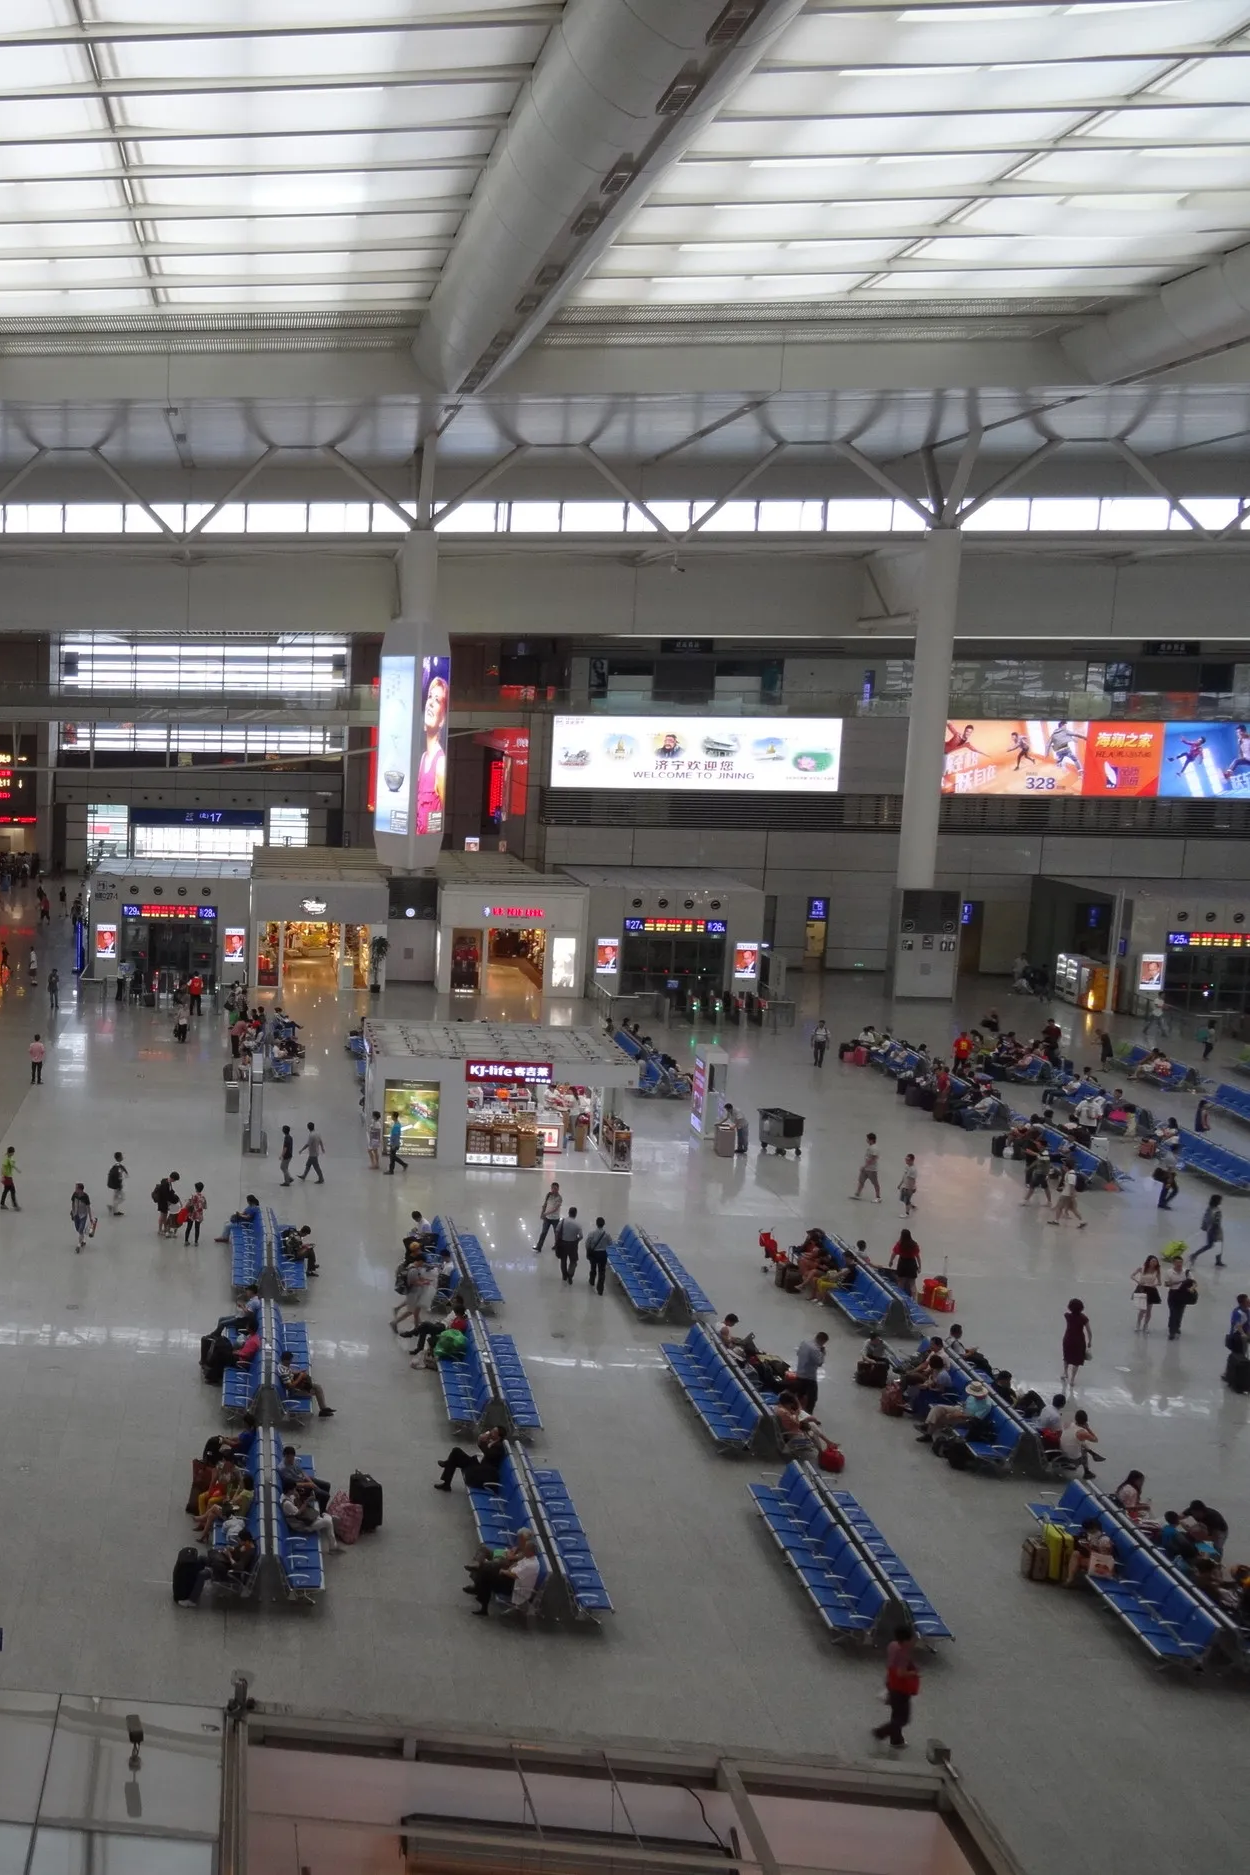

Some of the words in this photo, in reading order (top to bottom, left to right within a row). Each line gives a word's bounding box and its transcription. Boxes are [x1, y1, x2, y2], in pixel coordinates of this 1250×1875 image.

[1095, 732, 1153, 748] 海澜之家
[655, 760, 734, 771] 济宁欢迎您
[633, 771, 692, 780] WELCOME
[697, 772, 713, 780] TO
[717, 772, 755, 780] JINING
[1026, 777, 1055, 790] 328
[210, 813, 222, 822] 17
[470, 1065, 513, 1076] KJ-life
